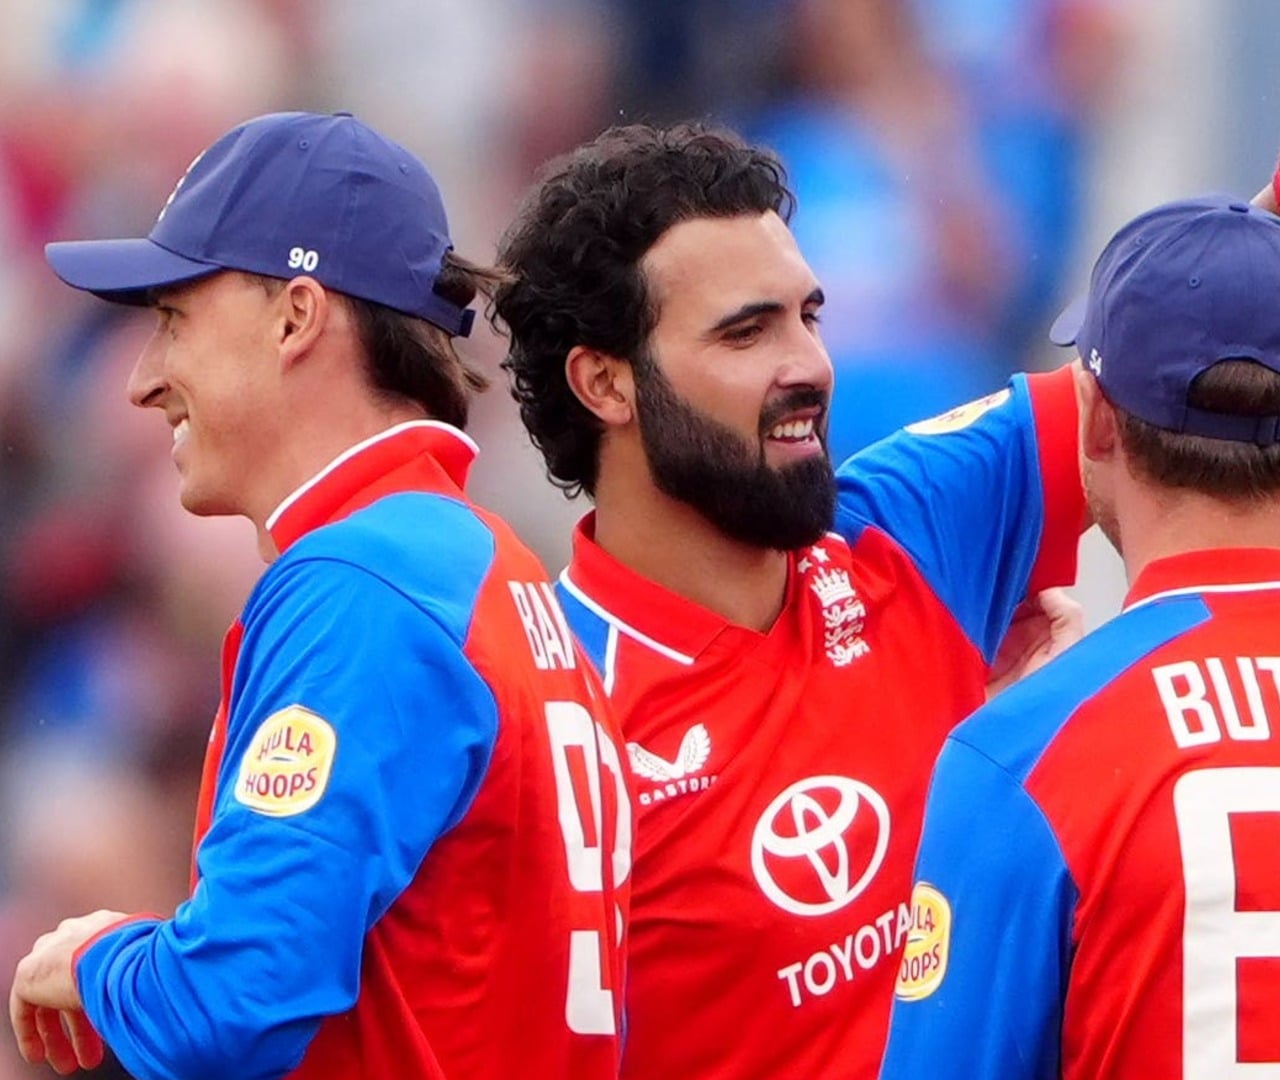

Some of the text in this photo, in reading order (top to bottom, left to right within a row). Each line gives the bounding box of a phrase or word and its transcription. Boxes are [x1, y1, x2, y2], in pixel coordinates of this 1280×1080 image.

[287, 247, 318, 272] 90
[257, 726, 314, 761] HULA
[245, 767, 318, 798] HOOPS
[777, 902, 913, 1007] TOYOTA
